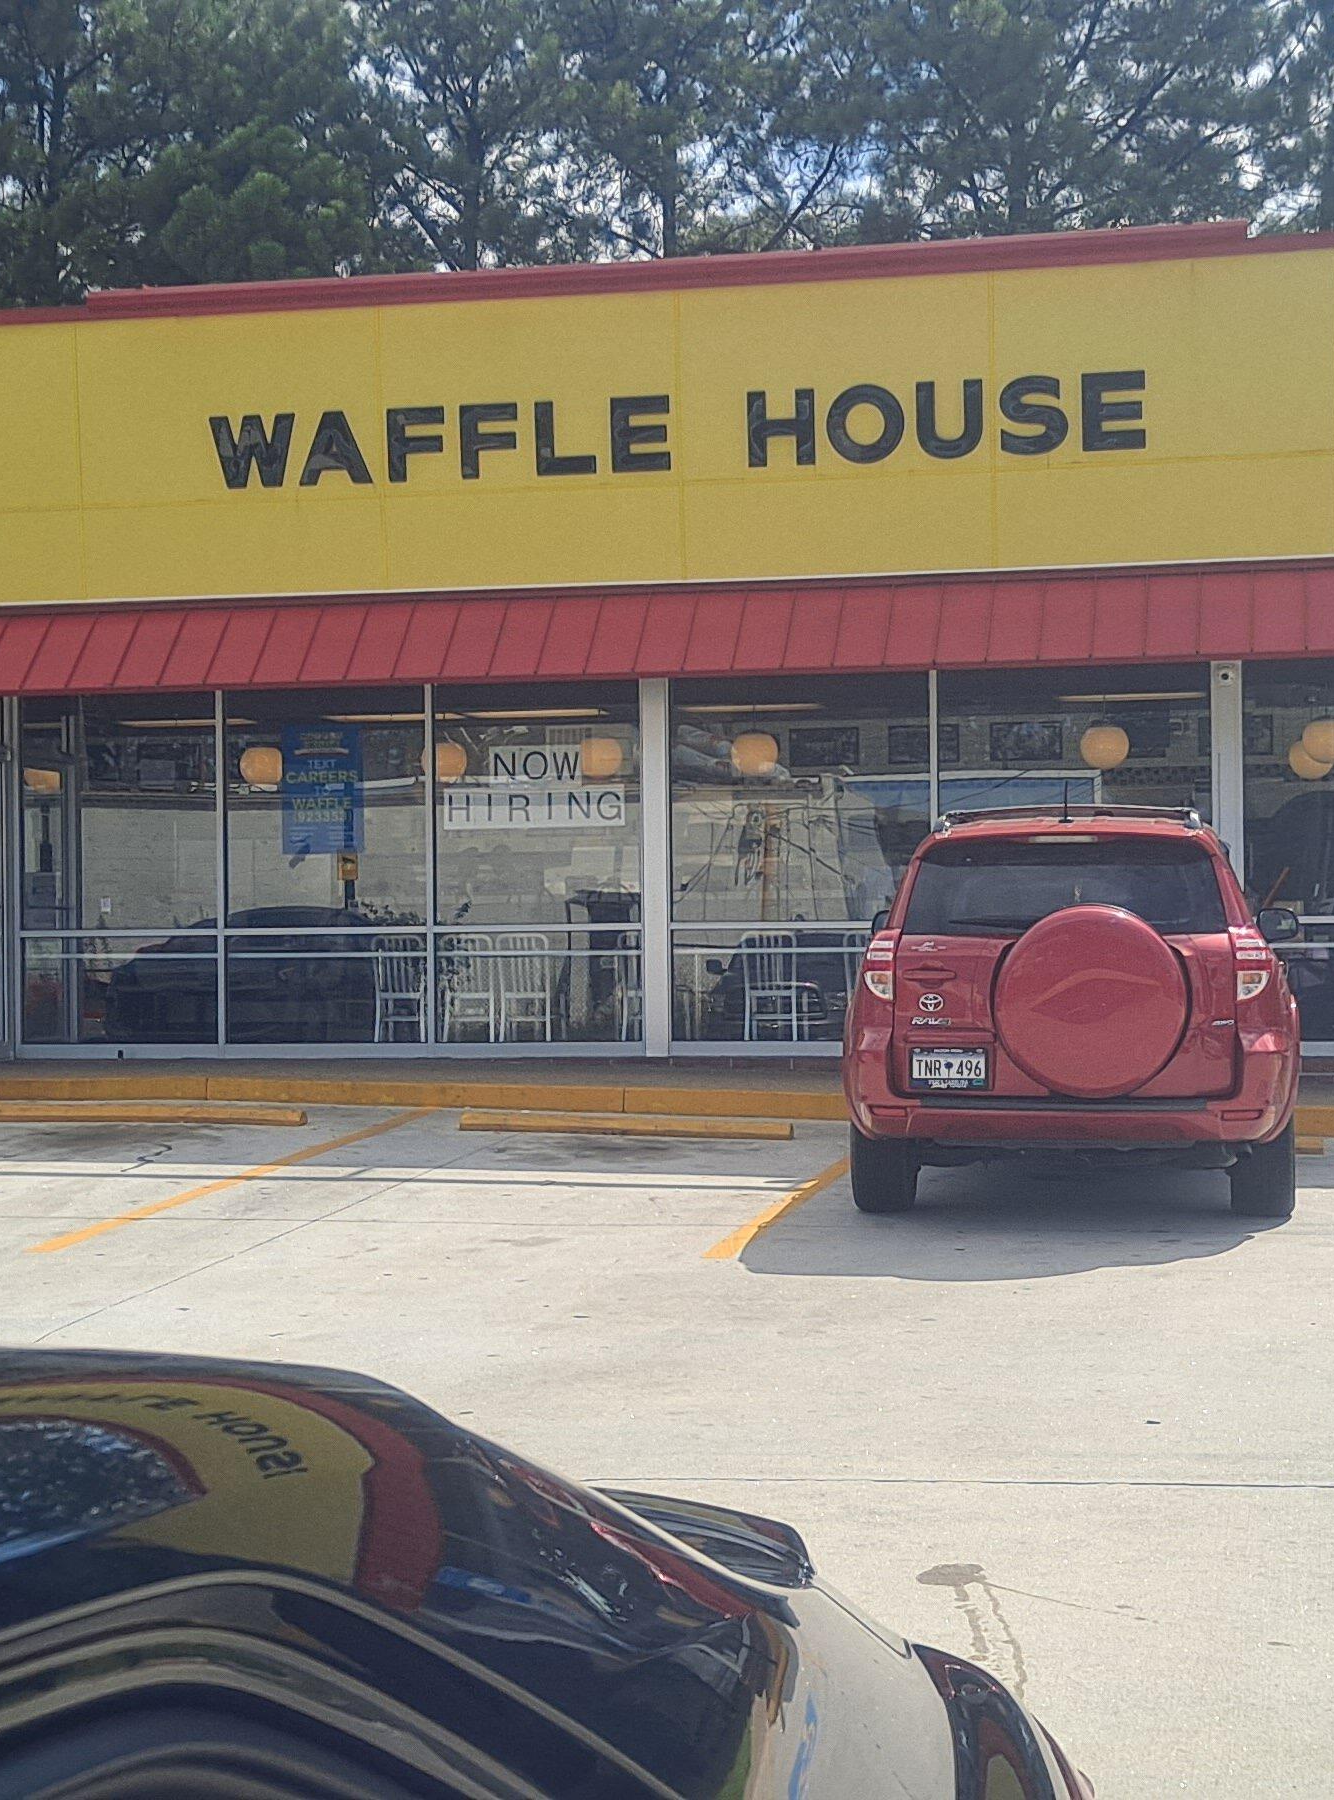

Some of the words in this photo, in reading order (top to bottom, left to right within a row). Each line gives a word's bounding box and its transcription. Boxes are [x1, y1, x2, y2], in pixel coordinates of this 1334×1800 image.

[208, 395, 671, 489] WAFFLE
[746, 370, 1147, 468] HOUSE
[308, 760, 337, 770] TEXT
[493, 750, 579, 781] NOW
[286, 770, 358, 785] CAREERS
[292, 797, 352, 811] WAFFLE
[448, 790, 622, 822] HIRING
[916, 1059, 942, 1077] TNR
[956, 1059, 982, 1078] 496
